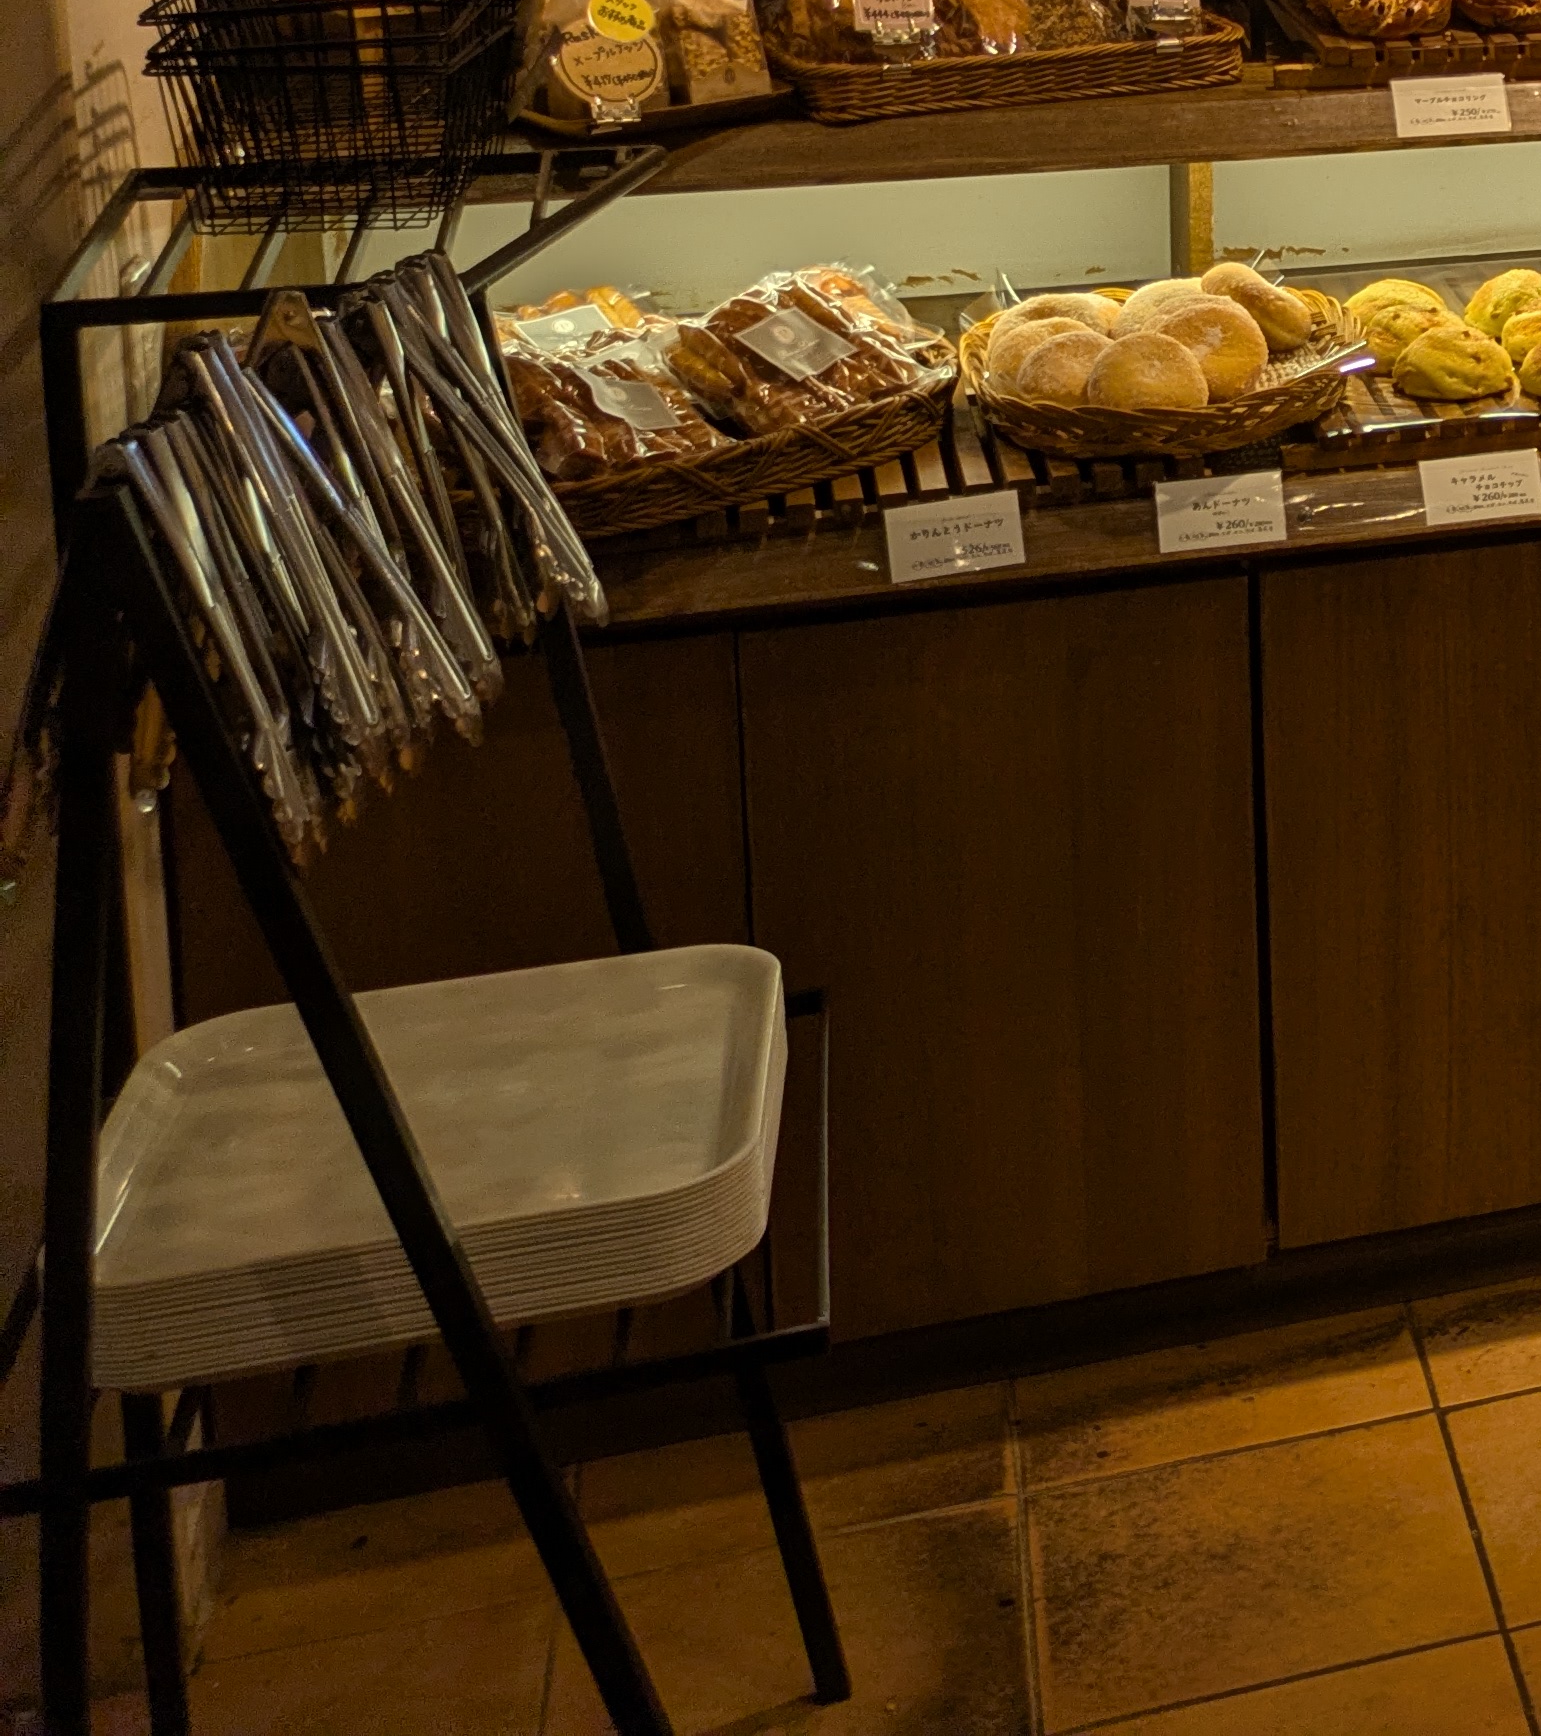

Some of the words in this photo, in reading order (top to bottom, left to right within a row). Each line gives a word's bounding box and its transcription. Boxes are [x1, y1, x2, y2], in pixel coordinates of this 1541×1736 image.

[1450, 473, 1497, 487] キャラメル
[1475, 479, 1524, 492] チョコチップ
[1191, 497, 1251, 512] あんドーナツ
[909, 516, 1005, 540] かりんとうドーナツ
